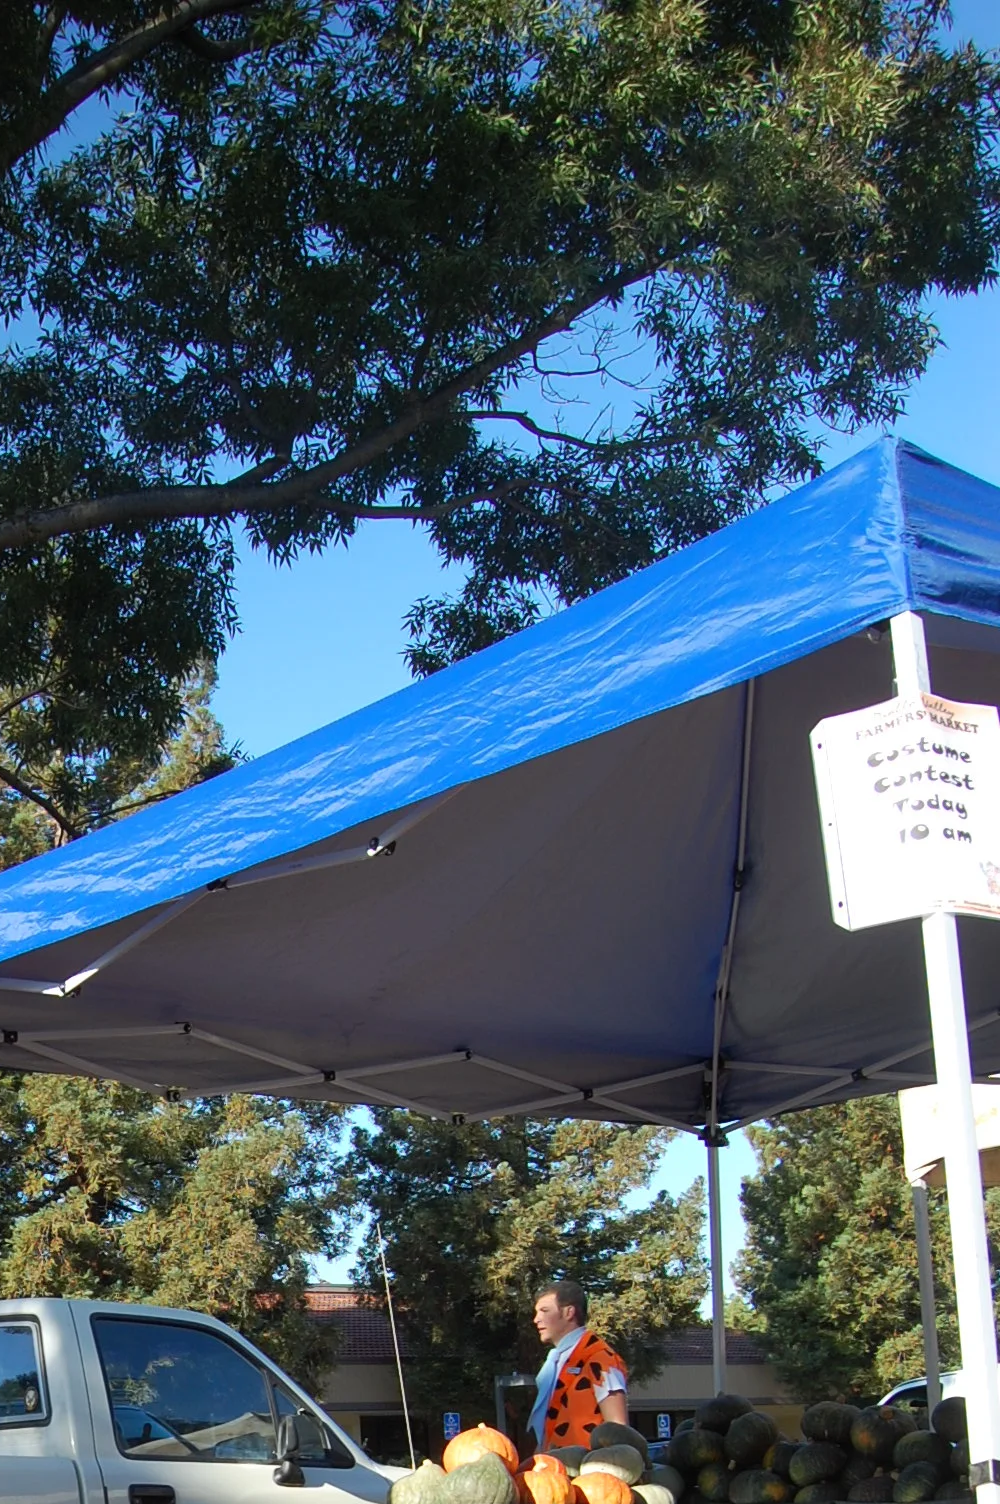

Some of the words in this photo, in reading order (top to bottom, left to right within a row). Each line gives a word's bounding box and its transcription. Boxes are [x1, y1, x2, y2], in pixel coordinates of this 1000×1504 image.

[929, 712, 979, 734] MARKET
[867, 736, 972, 768] Costume
[874, 765, 975, 793] Contest
[892, 794, 968, 819] Today
[899, 823, 930, 844] 10
[942, 826, 972, 844] am
